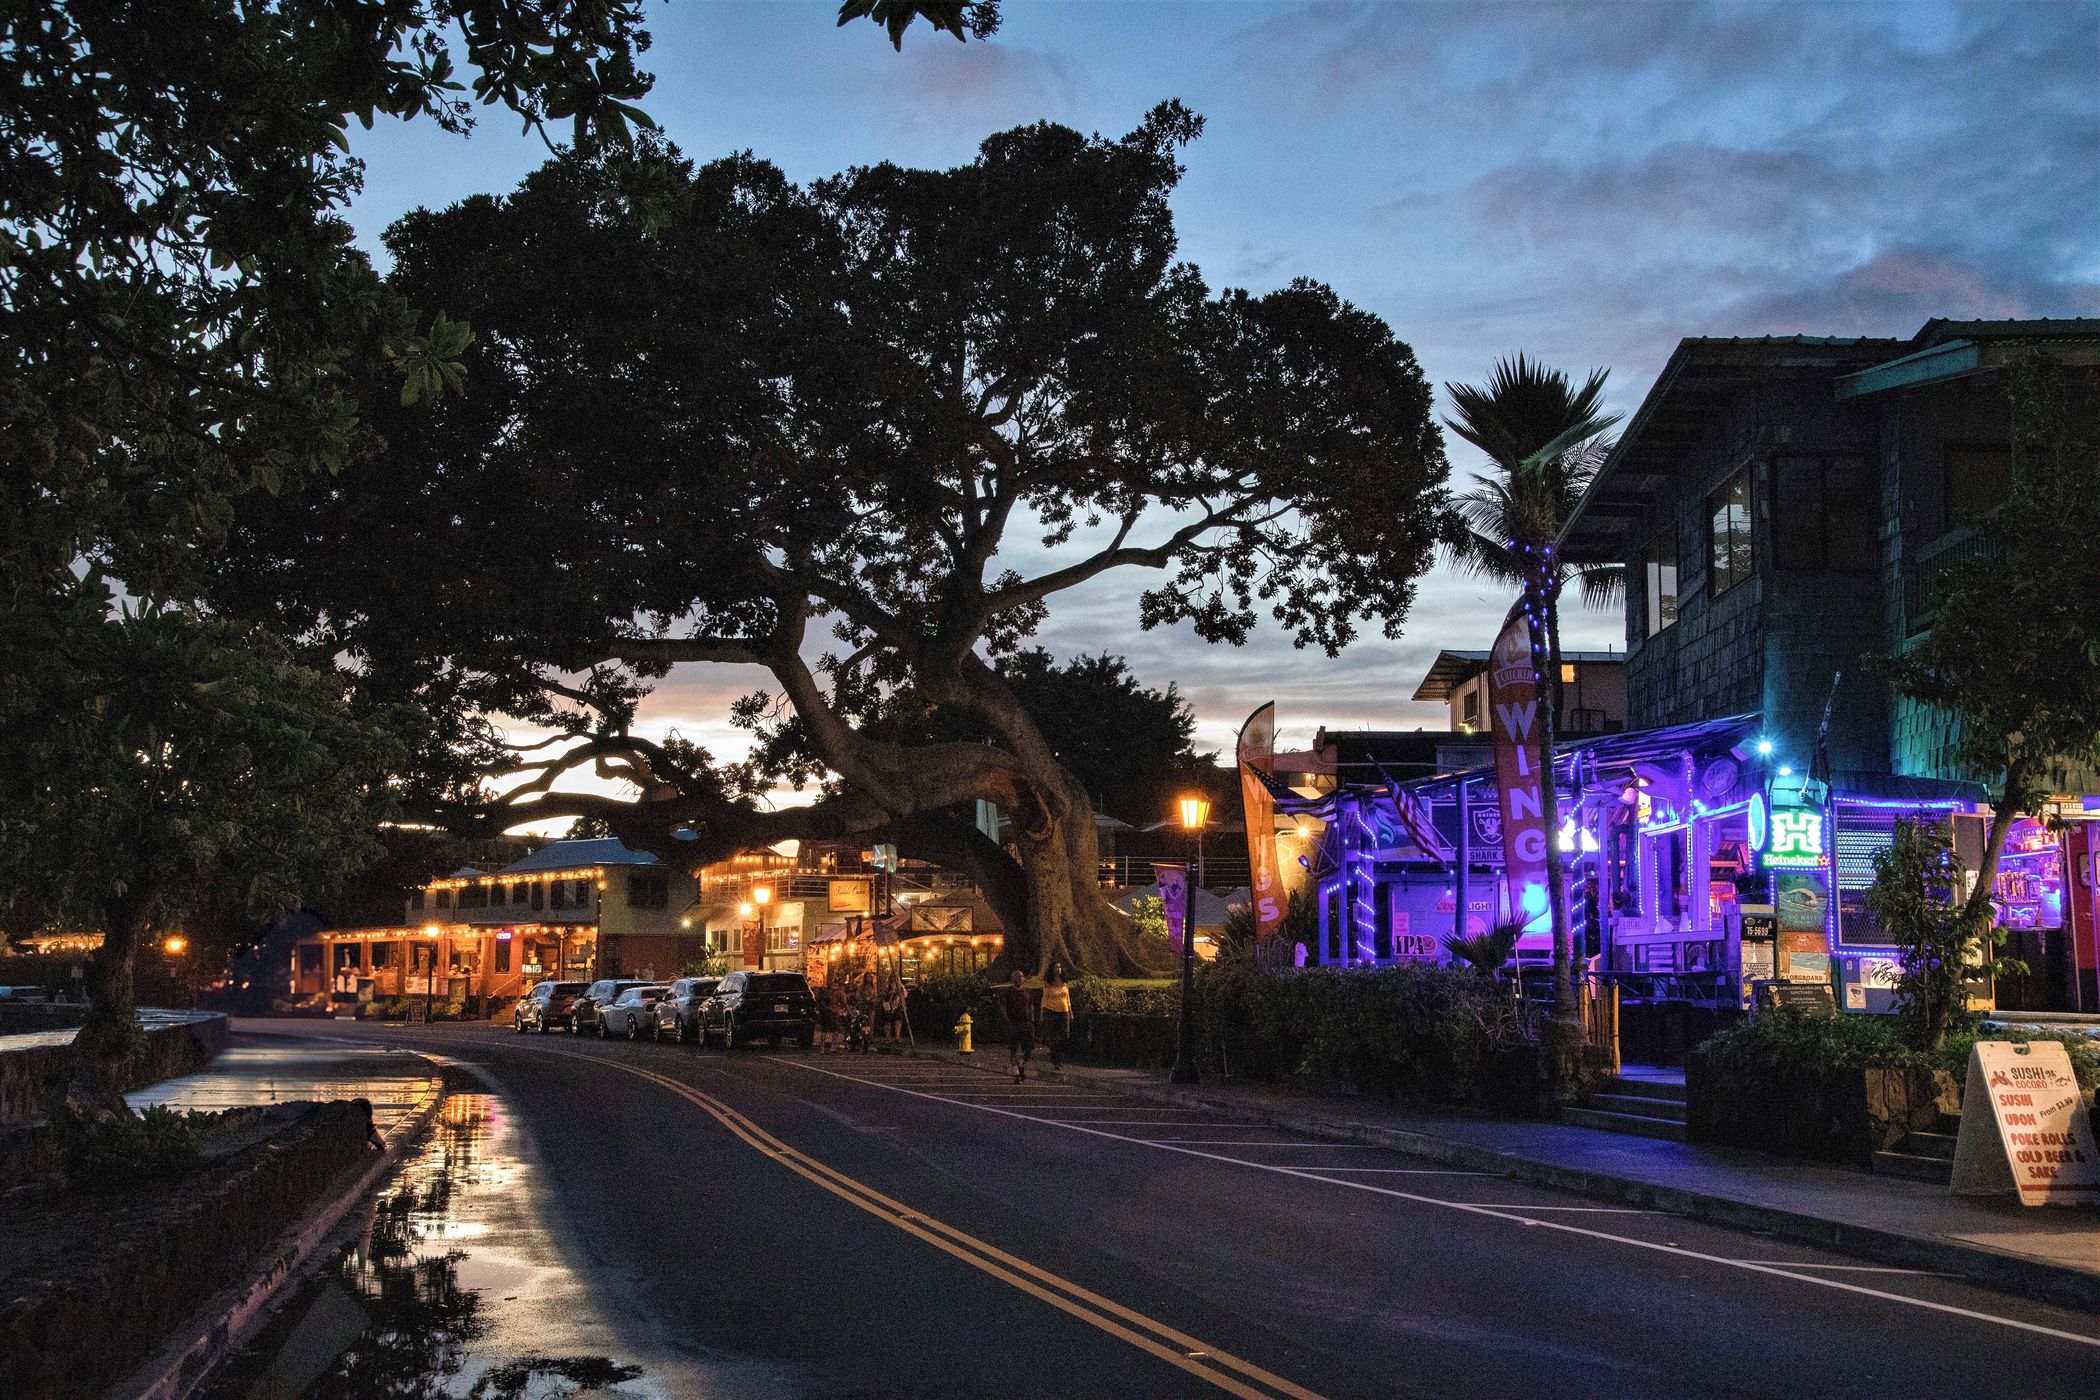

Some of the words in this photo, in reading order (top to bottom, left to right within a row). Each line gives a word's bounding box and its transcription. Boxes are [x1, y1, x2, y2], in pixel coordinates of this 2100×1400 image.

[1469, 851, 1498, 860] SHARK
[1763, 854, 1818, 867] Heineken
[1467, 902, 1492, 911] LIGHT
[1395, 935, 1425, 955] IPA
[2010, 1067, 2046, 1080] SUSHI
[2015, 1080, 2048, 1089] COCORO
[1999, 1094, 2034, 1107] SUSHI
[2004, 1113, 2037, 1126] UDON
[2039, 1107, 2057, 1119] From
[2010, 1133, 2039, 1146] POKE
[2041, 1132, 2076, 1146] ROLLS
[2016, 1150, 2043, 1163] COLD
[2046, 1150, 2074, 1163] BEER
[2028, 1165, 2058, 1179] SAKE
